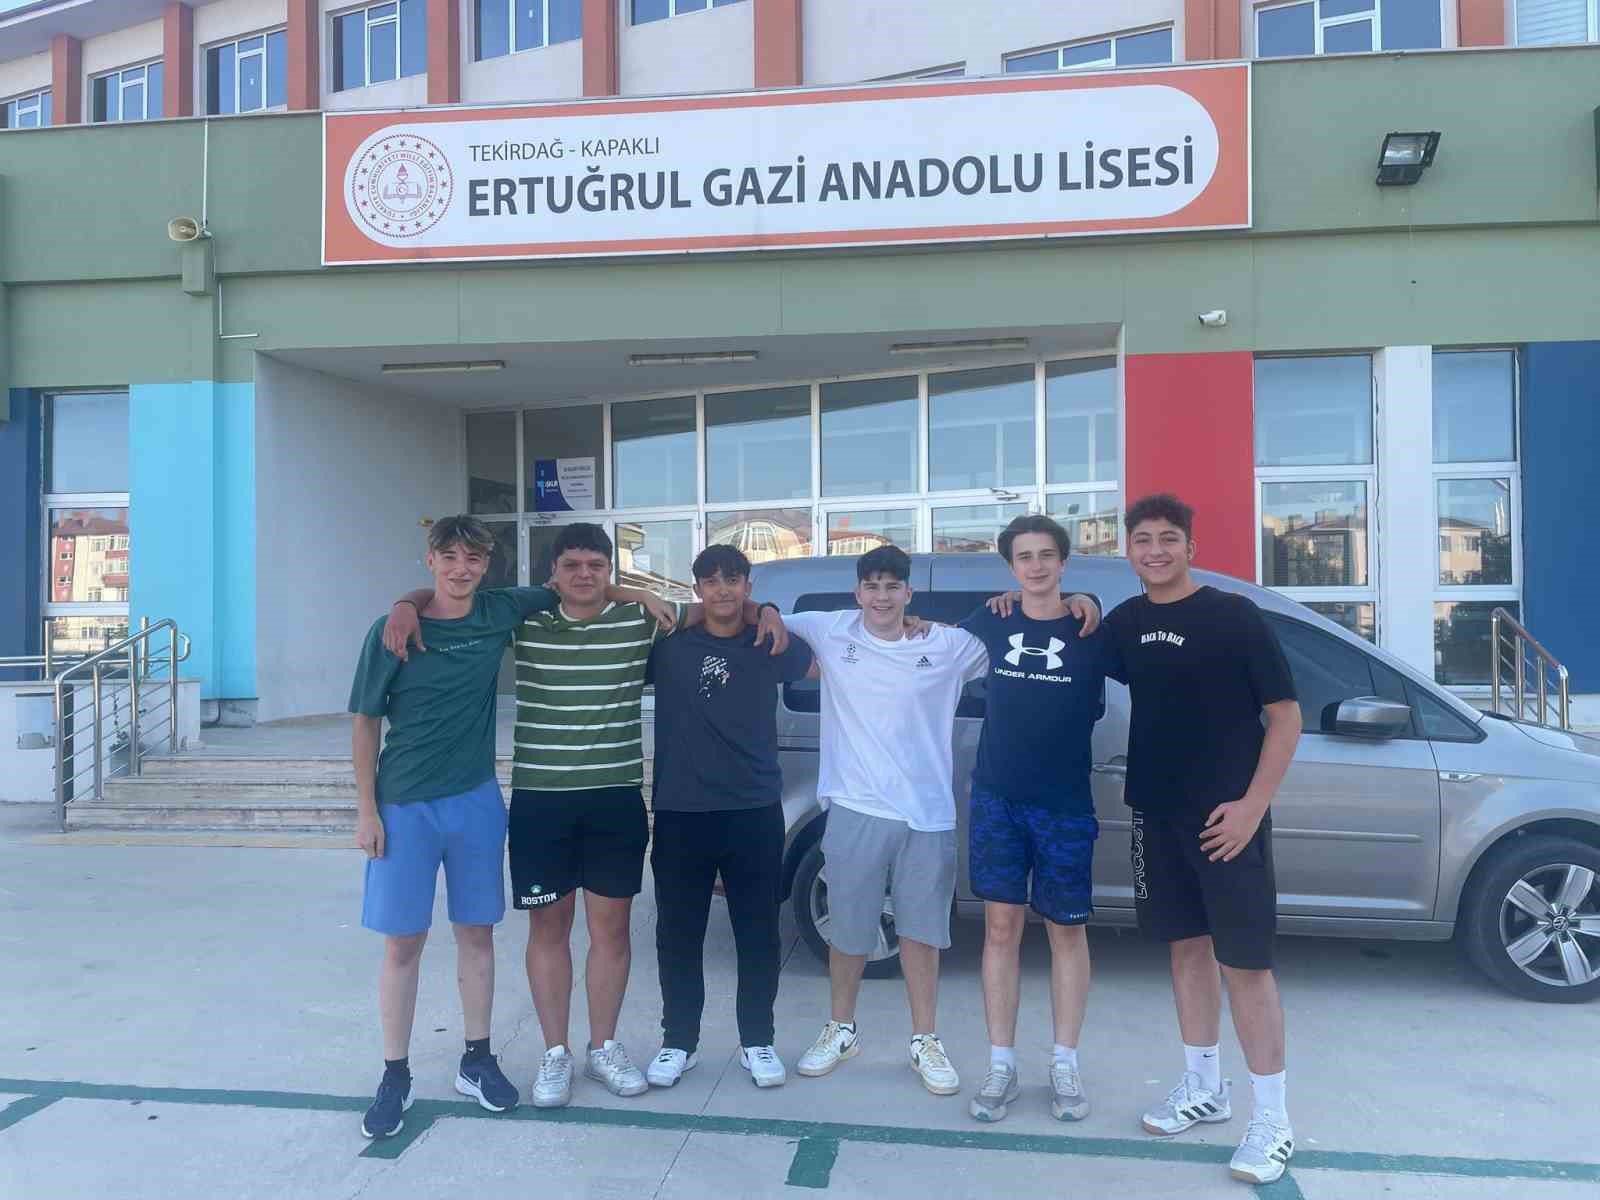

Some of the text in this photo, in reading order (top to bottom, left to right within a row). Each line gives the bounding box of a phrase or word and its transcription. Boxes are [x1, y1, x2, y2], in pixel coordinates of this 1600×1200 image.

[469, 138, 564, 162] TEKİRDAĞ
[581, 136, 659, 158] KAPAKLI
[469, 135, 1194, 217] ERTUĞRUL GAZİ ANADOLU LİSESİ
[1157, 630, 1167, 641] TO
[994, 667, 1072, 683] UNDER ARMOUR
[520, 891, 558, 905] BOSTON
